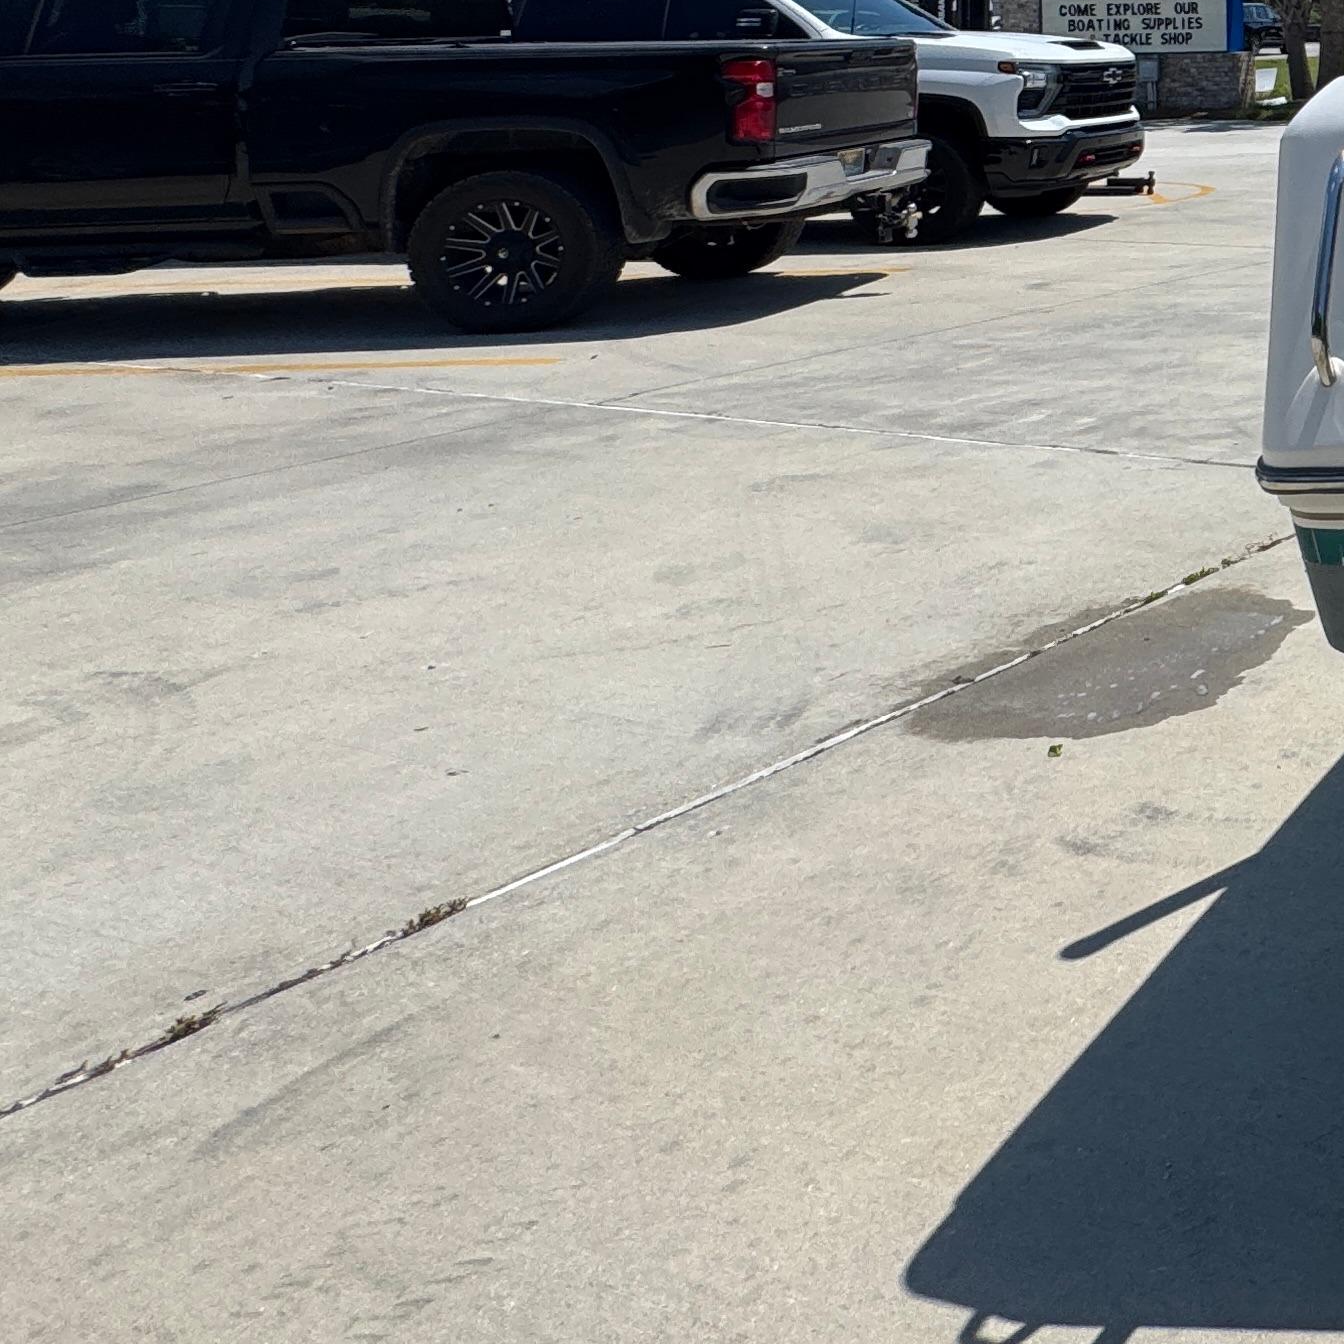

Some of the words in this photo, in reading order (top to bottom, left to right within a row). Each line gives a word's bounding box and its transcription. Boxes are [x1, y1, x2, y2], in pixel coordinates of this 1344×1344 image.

[1059, 3, 1097, 17] COME
[1106, 2, 1161, 16] EXPLORE
[1174, 2, 1199, 14] OUR
[1068, 19, 1130, 32] BOATING
[1142, 17, 1203, 30] SUPPLIES
[1103, 33, 1153, 46] TACKLE
[1161, 32, 1193, 45] SHOP
